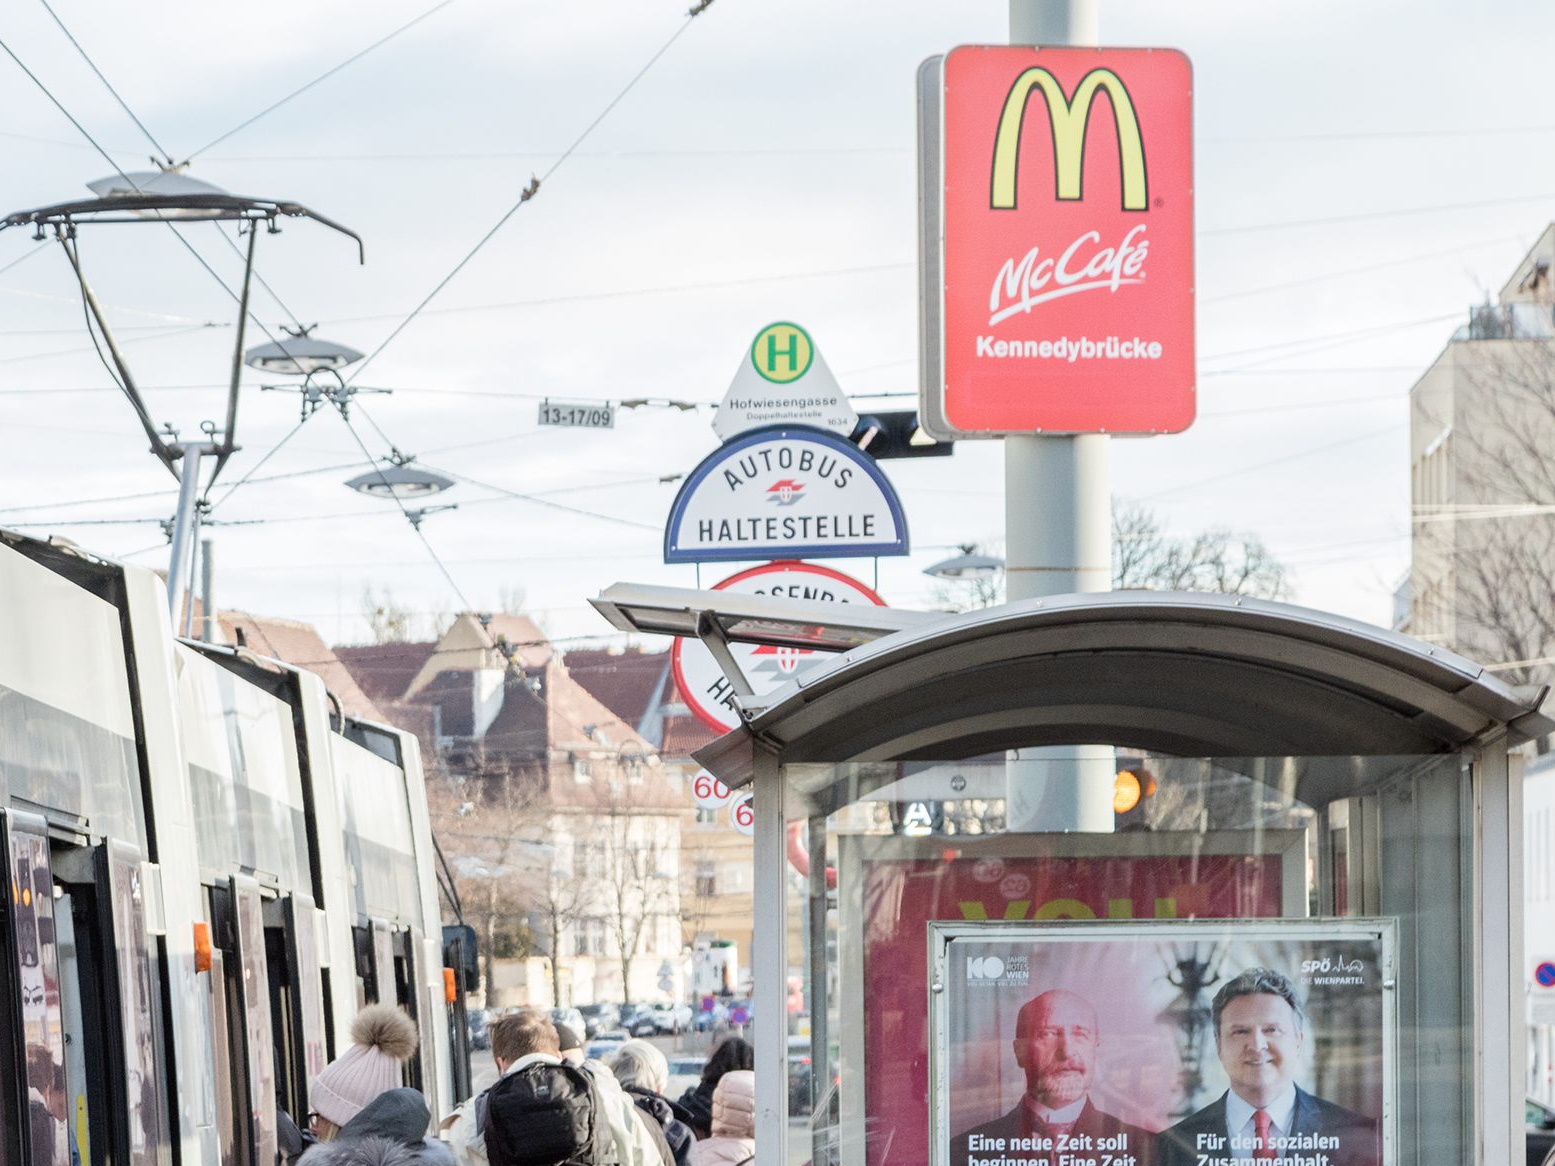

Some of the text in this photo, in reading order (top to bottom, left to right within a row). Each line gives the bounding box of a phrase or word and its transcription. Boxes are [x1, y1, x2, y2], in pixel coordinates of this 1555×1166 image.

[989, 224, 1149, 315] McCafé
[767, 334, 797, 371] H
[976, 335, 1163, 362] Kennedybrücke
[730, 397, 837, 409] Hofwiesengasse
[543, 408, 610, 426] 13-17/09
[746, 411, 822, 421] Doppelhaltestelle
[723, 447, 853, 491] AUTOBUS
[699, 515, 875, 542] HALTESTELLE
[694, 776, 731, 799] 60
[736, 803, 754, 826] 6
[1301, 957, 1331, 973] SPÖ
[1006, 971, 1029, 979] WIEN
[1314, 977, 1364, 985] WIENPARTEI.
[968, 1133, 1128, 1151] Eine neue Zeit soll
[1196, 1132, 1339, 1150] Für den sozialen
